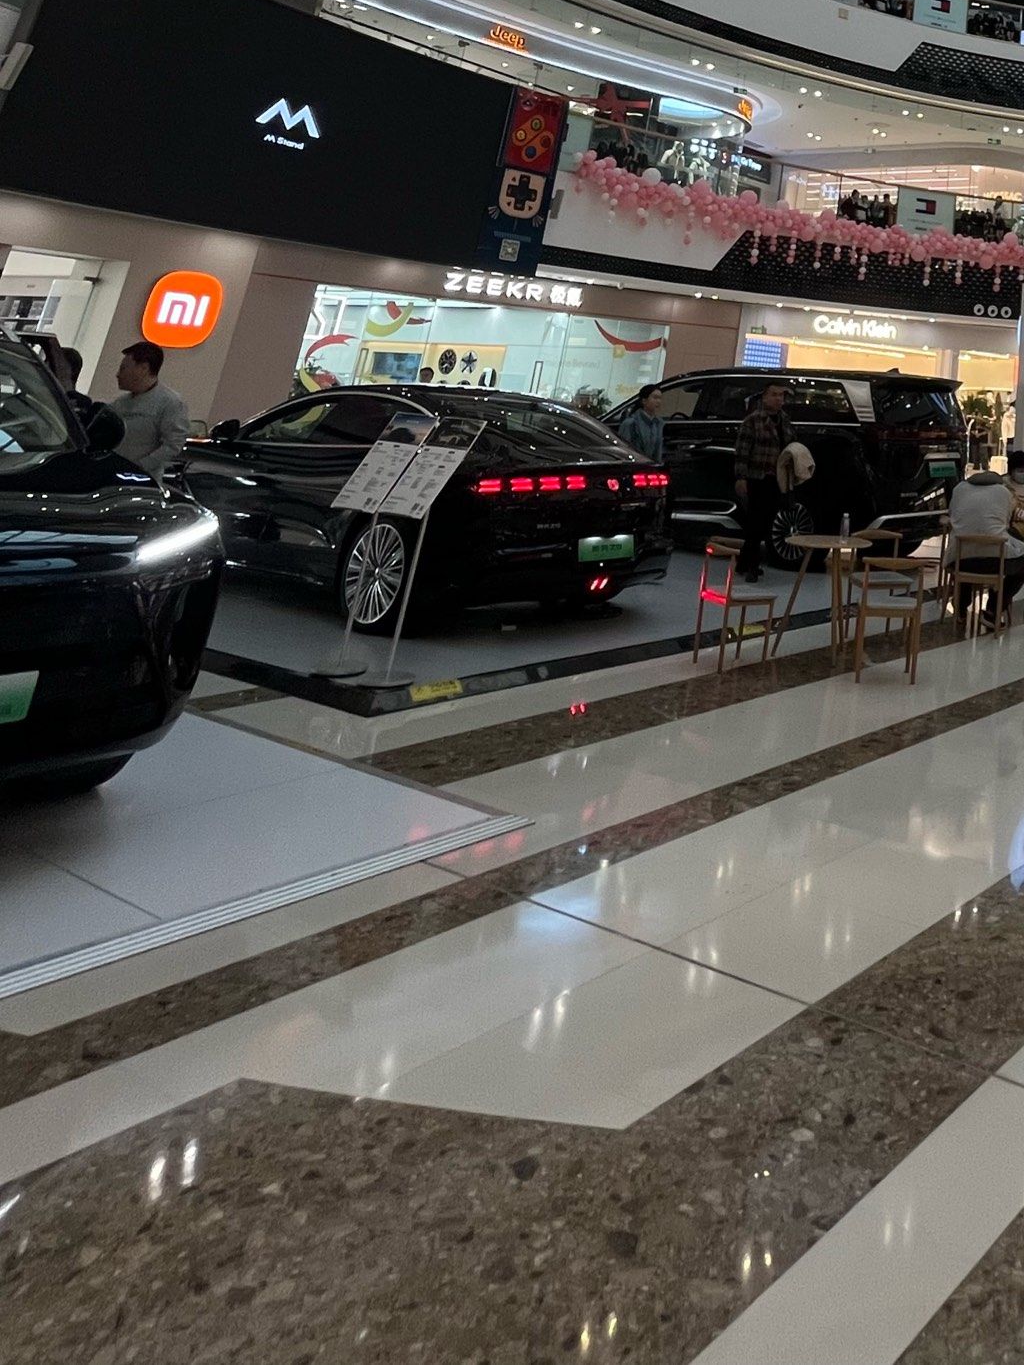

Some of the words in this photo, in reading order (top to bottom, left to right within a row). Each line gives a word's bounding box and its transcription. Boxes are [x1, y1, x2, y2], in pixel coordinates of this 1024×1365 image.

[490, 24, 526, 48] Jeep
[277, 136, 304, 150] Stand
[444, 272, 543, 302] ZEEKR
[813, 314, 860, 338] Calvin
[861, 319, 898, 340] Klein
